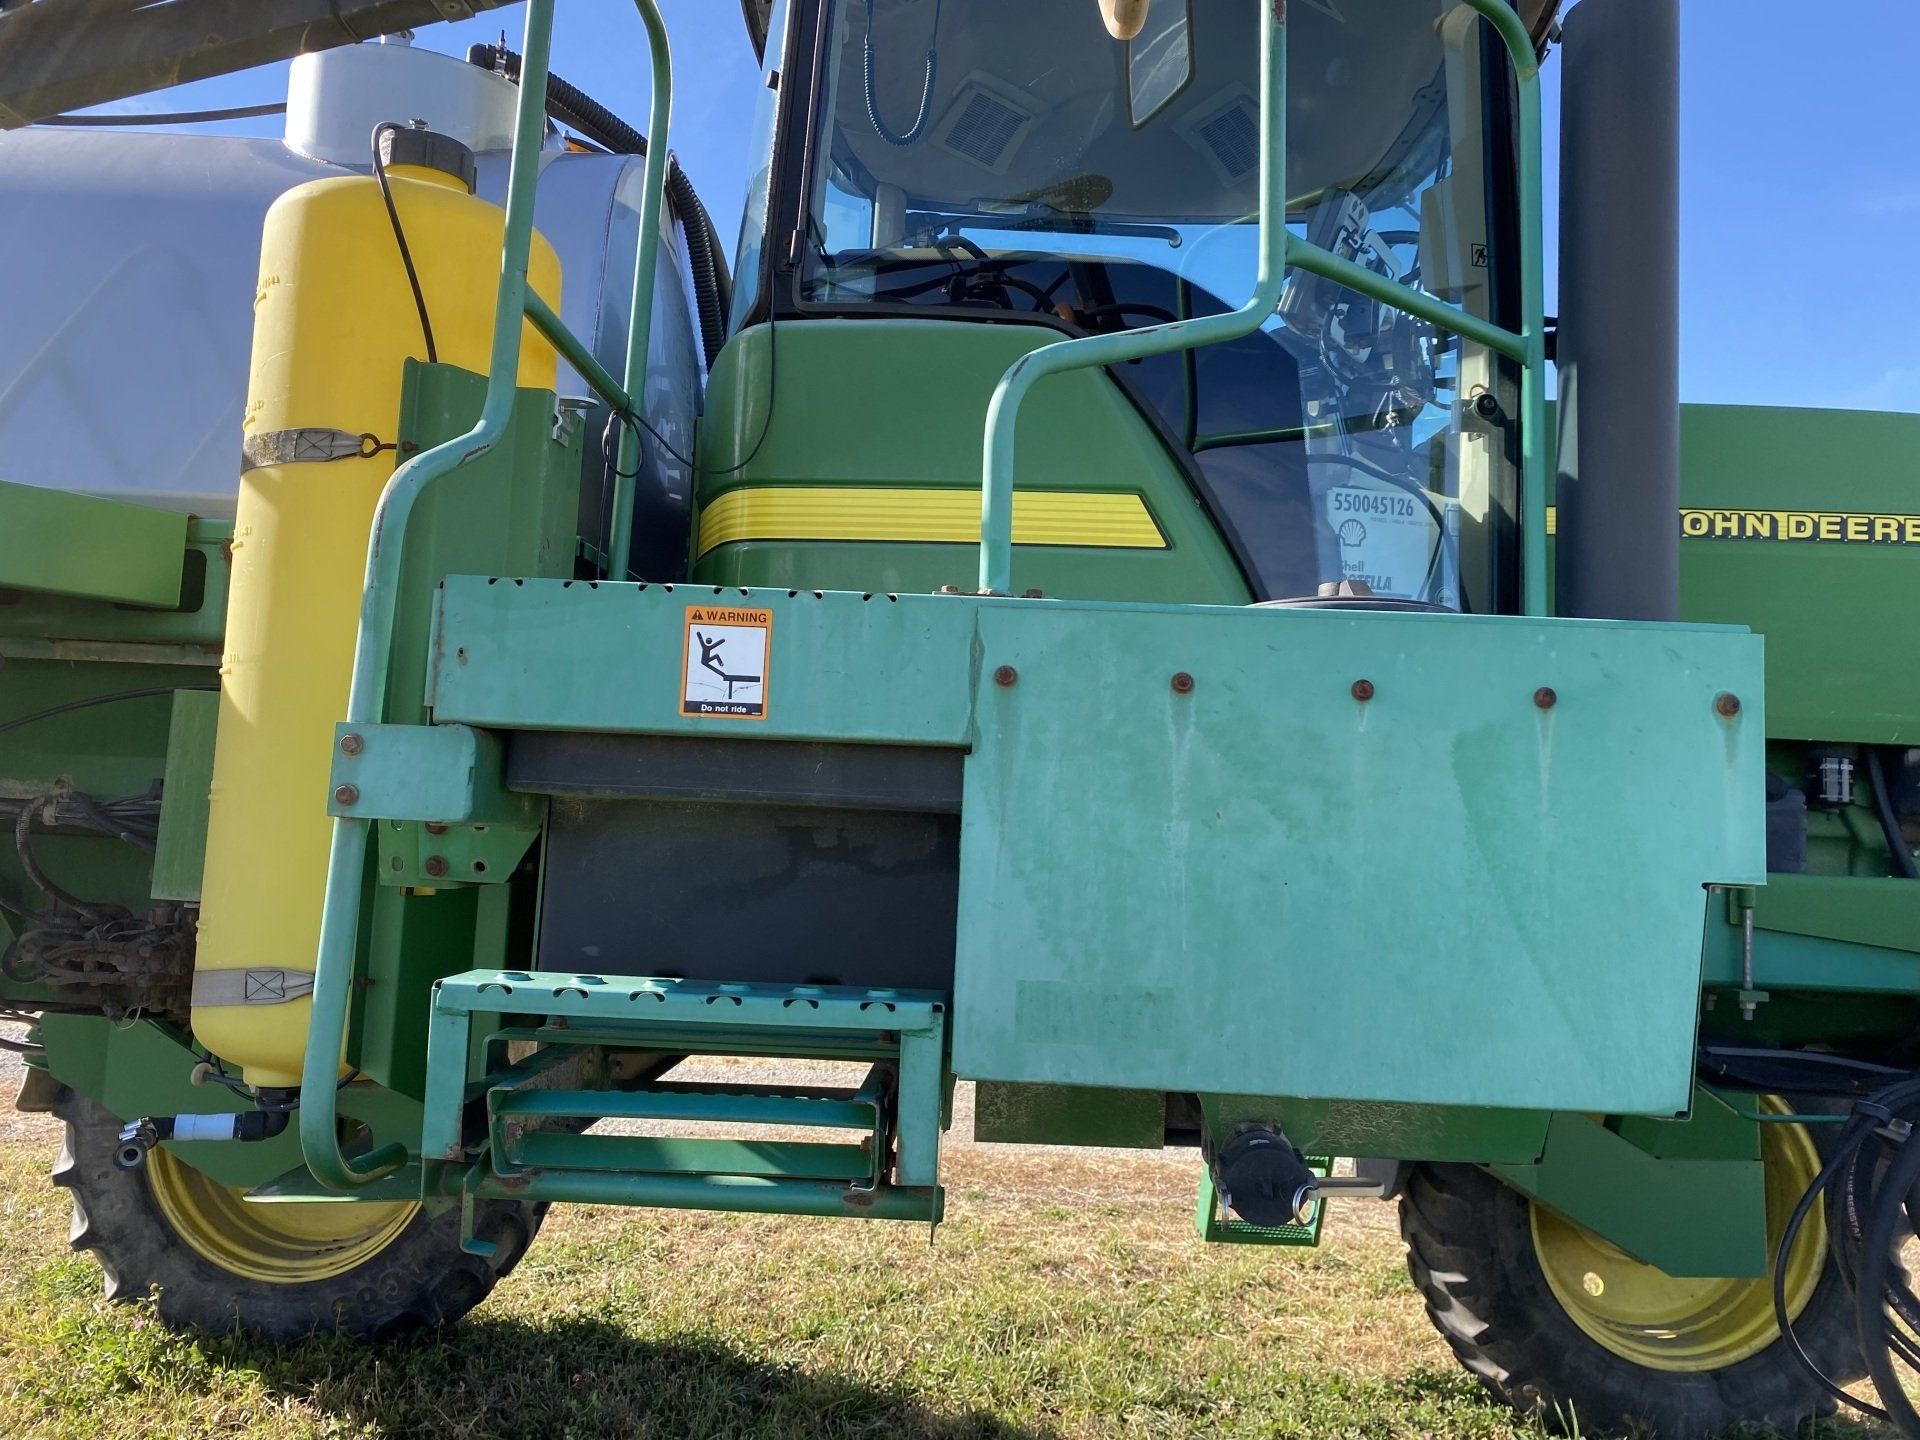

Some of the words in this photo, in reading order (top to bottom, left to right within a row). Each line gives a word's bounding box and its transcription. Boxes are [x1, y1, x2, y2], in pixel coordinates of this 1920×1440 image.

[1334, 492, 1414, 516] 550045126
[1682, 511, 1771, 537] OHN
[1788, 514, 1920, 542] DEERE
[706, 610, 767, 623] WARNING
[701, 703, 712, 712] Do
[715, 704, 729, 713] not
[731, 705, 747, 714] ride
